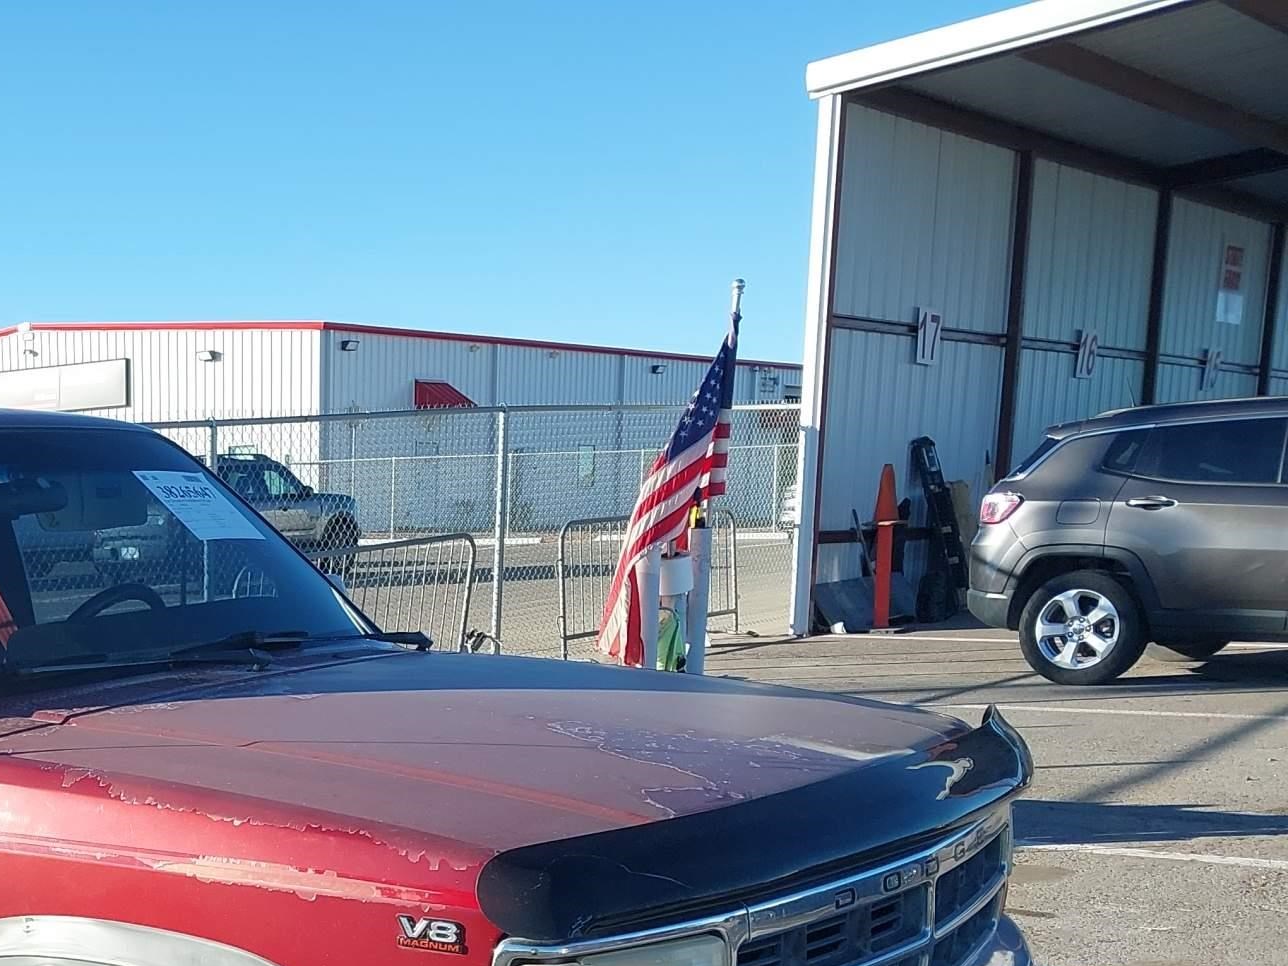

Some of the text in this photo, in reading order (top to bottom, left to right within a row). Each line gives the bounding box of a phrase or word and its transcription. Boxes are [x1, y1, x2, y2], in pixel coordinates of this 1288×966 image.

[920, 311, 941, 361] 17
[1080, 333, 1098, 376] 16
[156, 485, 217, 499] 38265647
[398, 915, 458, 943] V8
[398, 936, 460, 953] MAGNUM
